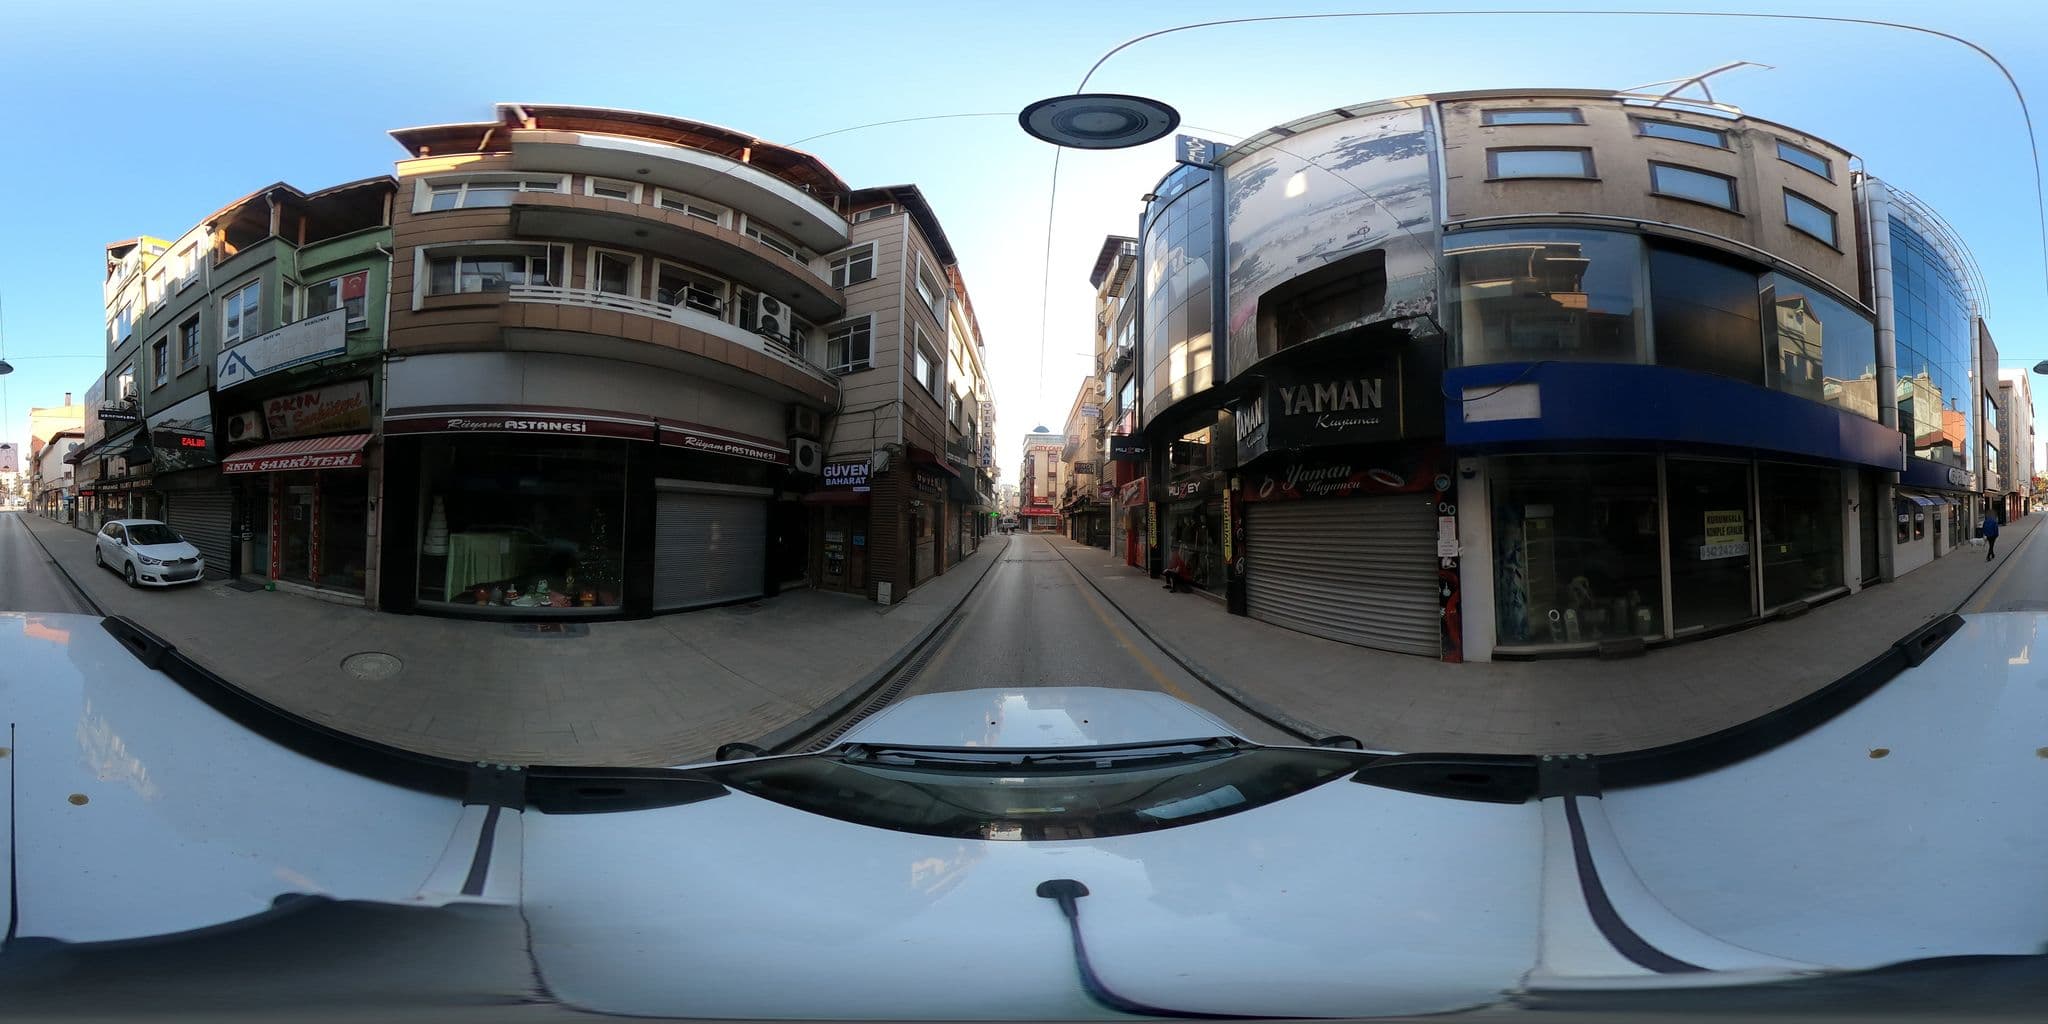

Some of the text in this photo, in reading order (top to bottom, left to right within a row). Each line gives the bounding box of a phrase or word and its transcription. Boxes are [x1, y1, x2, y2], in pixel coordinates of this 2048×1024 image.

[1279, 378, 1383, 416] YAMAN
[983, 402, 991, 428] OTEL
[1236, 396, 1265, 441] YAMAN
[1314, 414, 1380, 432] Kuyumcu
[447, 418, 587, 433] Rüyam ASTANESİ
[684, 436, 724, 450] Rüyam
[225, 453, 358, 473] AKIN ŞARKÜTERİ
[823, 463, 869, 478] GÜVEN
[825, 476, 867, 486] BAHARAT
[1281, 464, 1352, 491] Yaman
[1306, 479, 1361, 496] Kuyumcu
